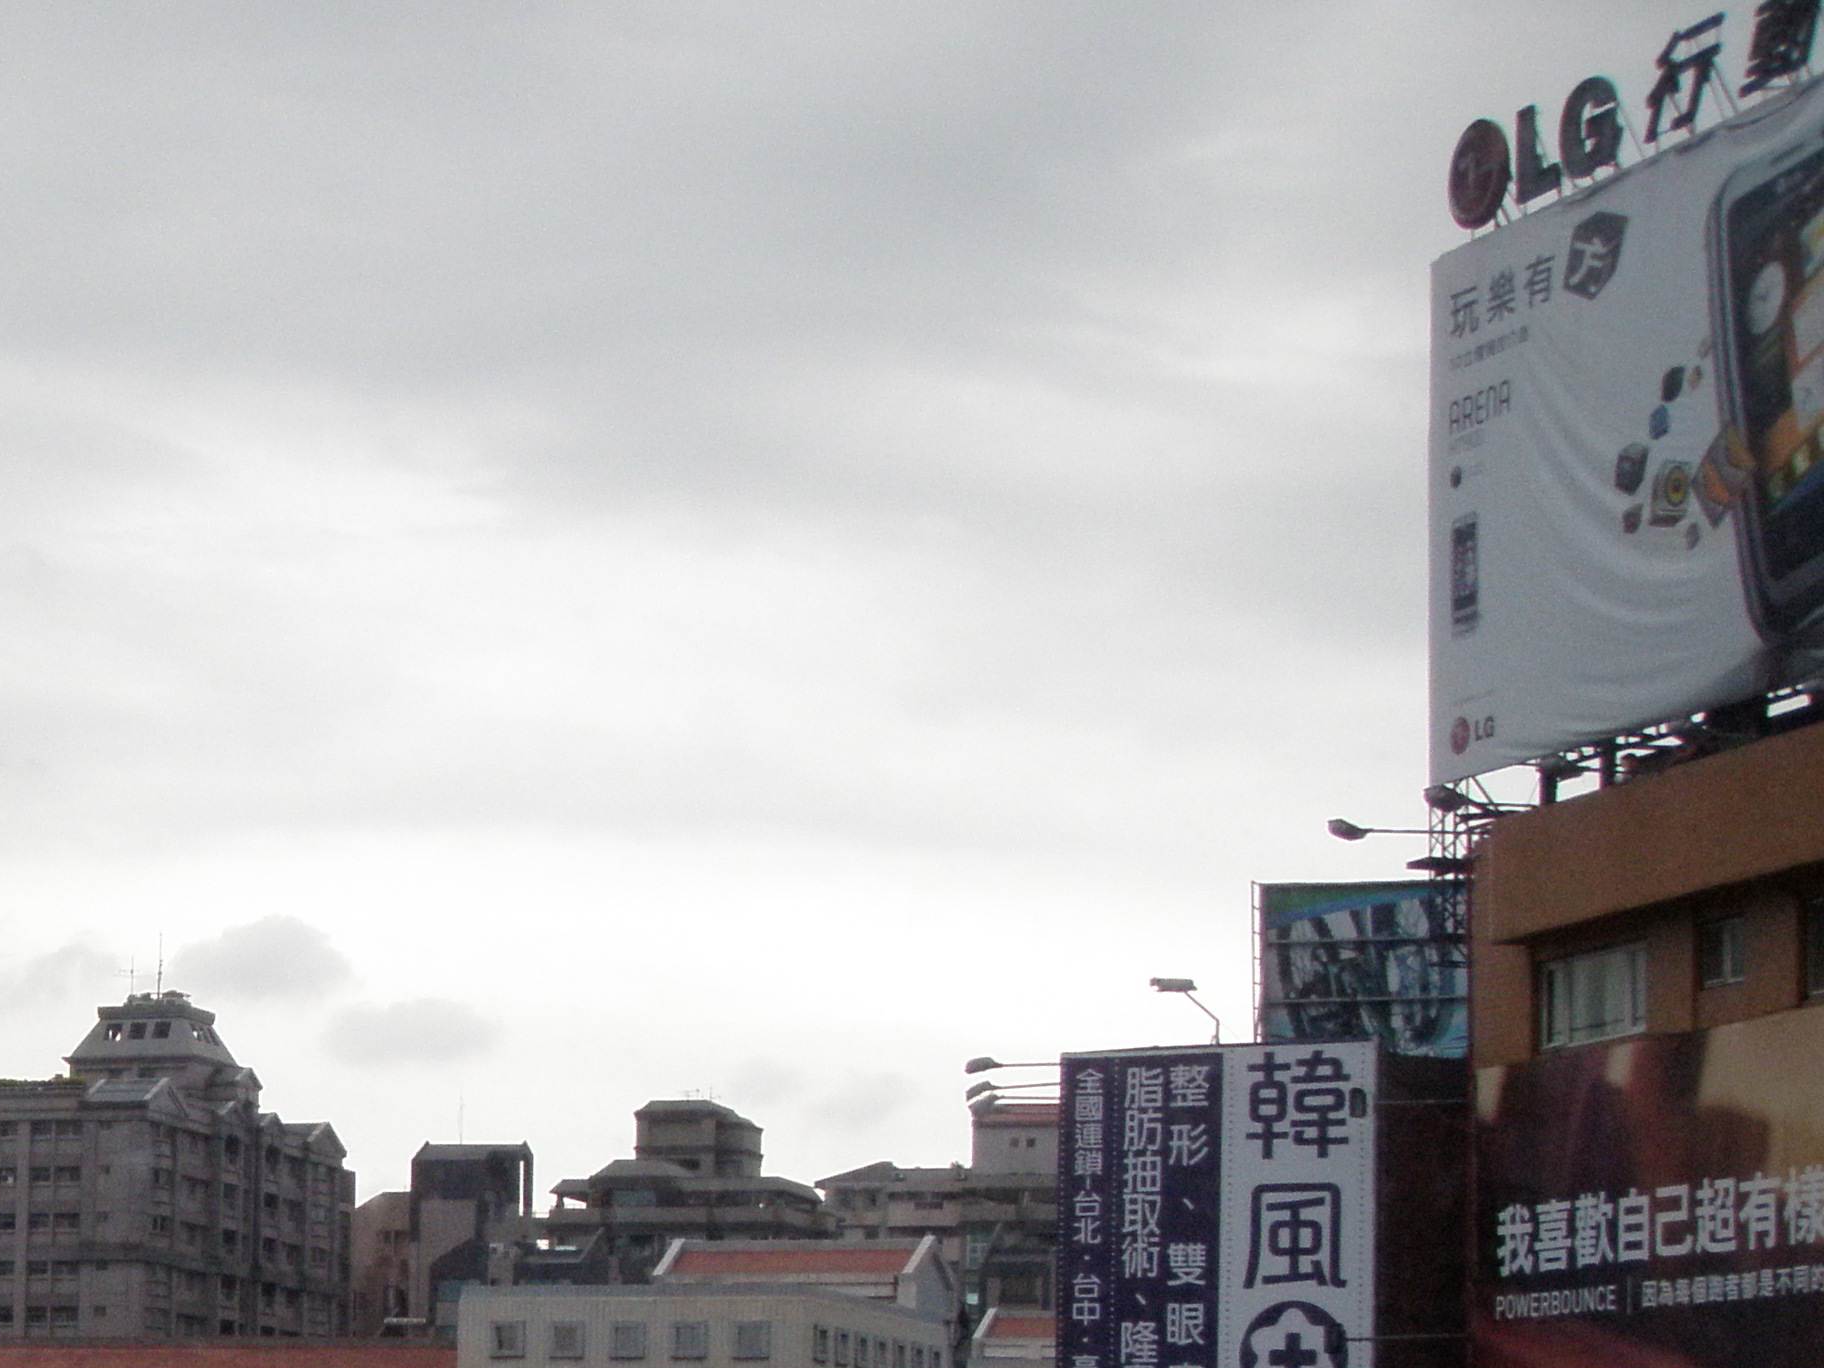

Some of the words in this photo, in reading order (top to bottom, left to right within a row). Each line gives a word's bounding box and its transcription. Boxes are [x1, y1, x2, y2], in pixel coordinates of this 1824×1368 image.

[1449, 379, 1510, 435] ARENA
[1474, 716, 1495, 741] LG
[1243, 1050, 1351, 1290] 韓風
[1495, 1284, 1617, 1321] POWERBOUNCE
